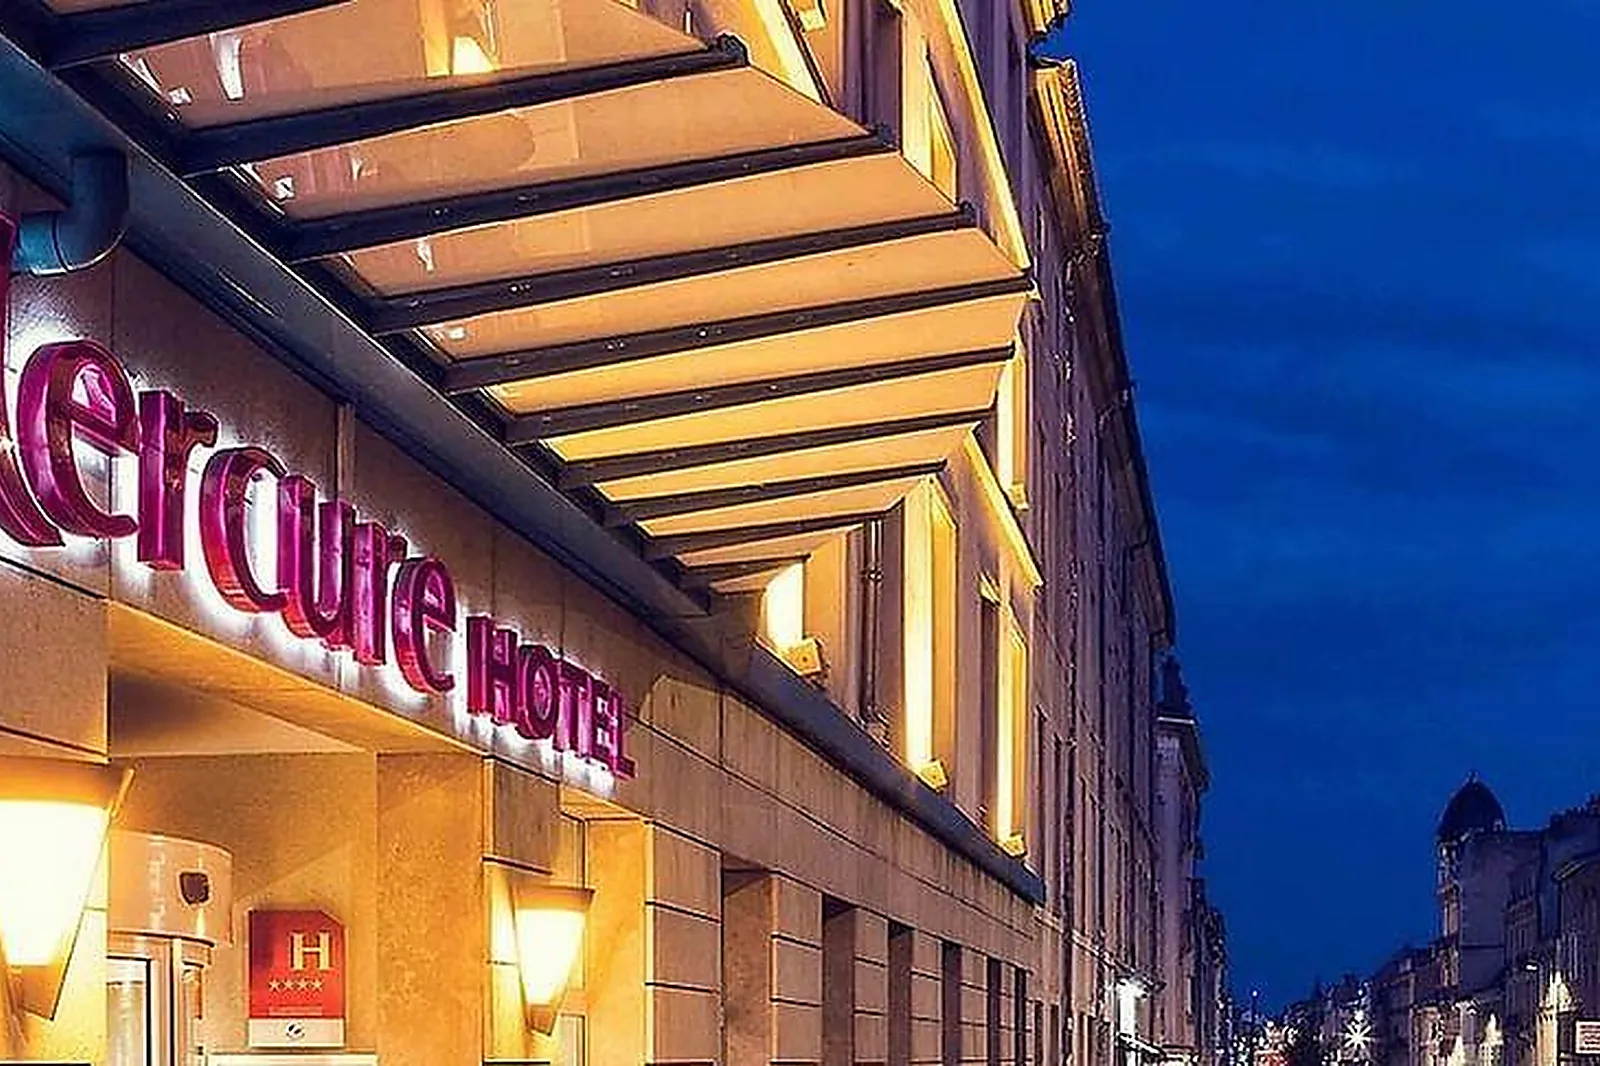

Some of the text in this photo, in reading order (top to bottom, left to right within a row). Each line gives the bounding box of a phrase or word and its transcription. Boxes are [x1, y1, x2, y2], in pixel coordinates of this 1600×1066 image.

[0, 212, 636, 780] ercure HOTEL
[291, 931, 331, 970] H
